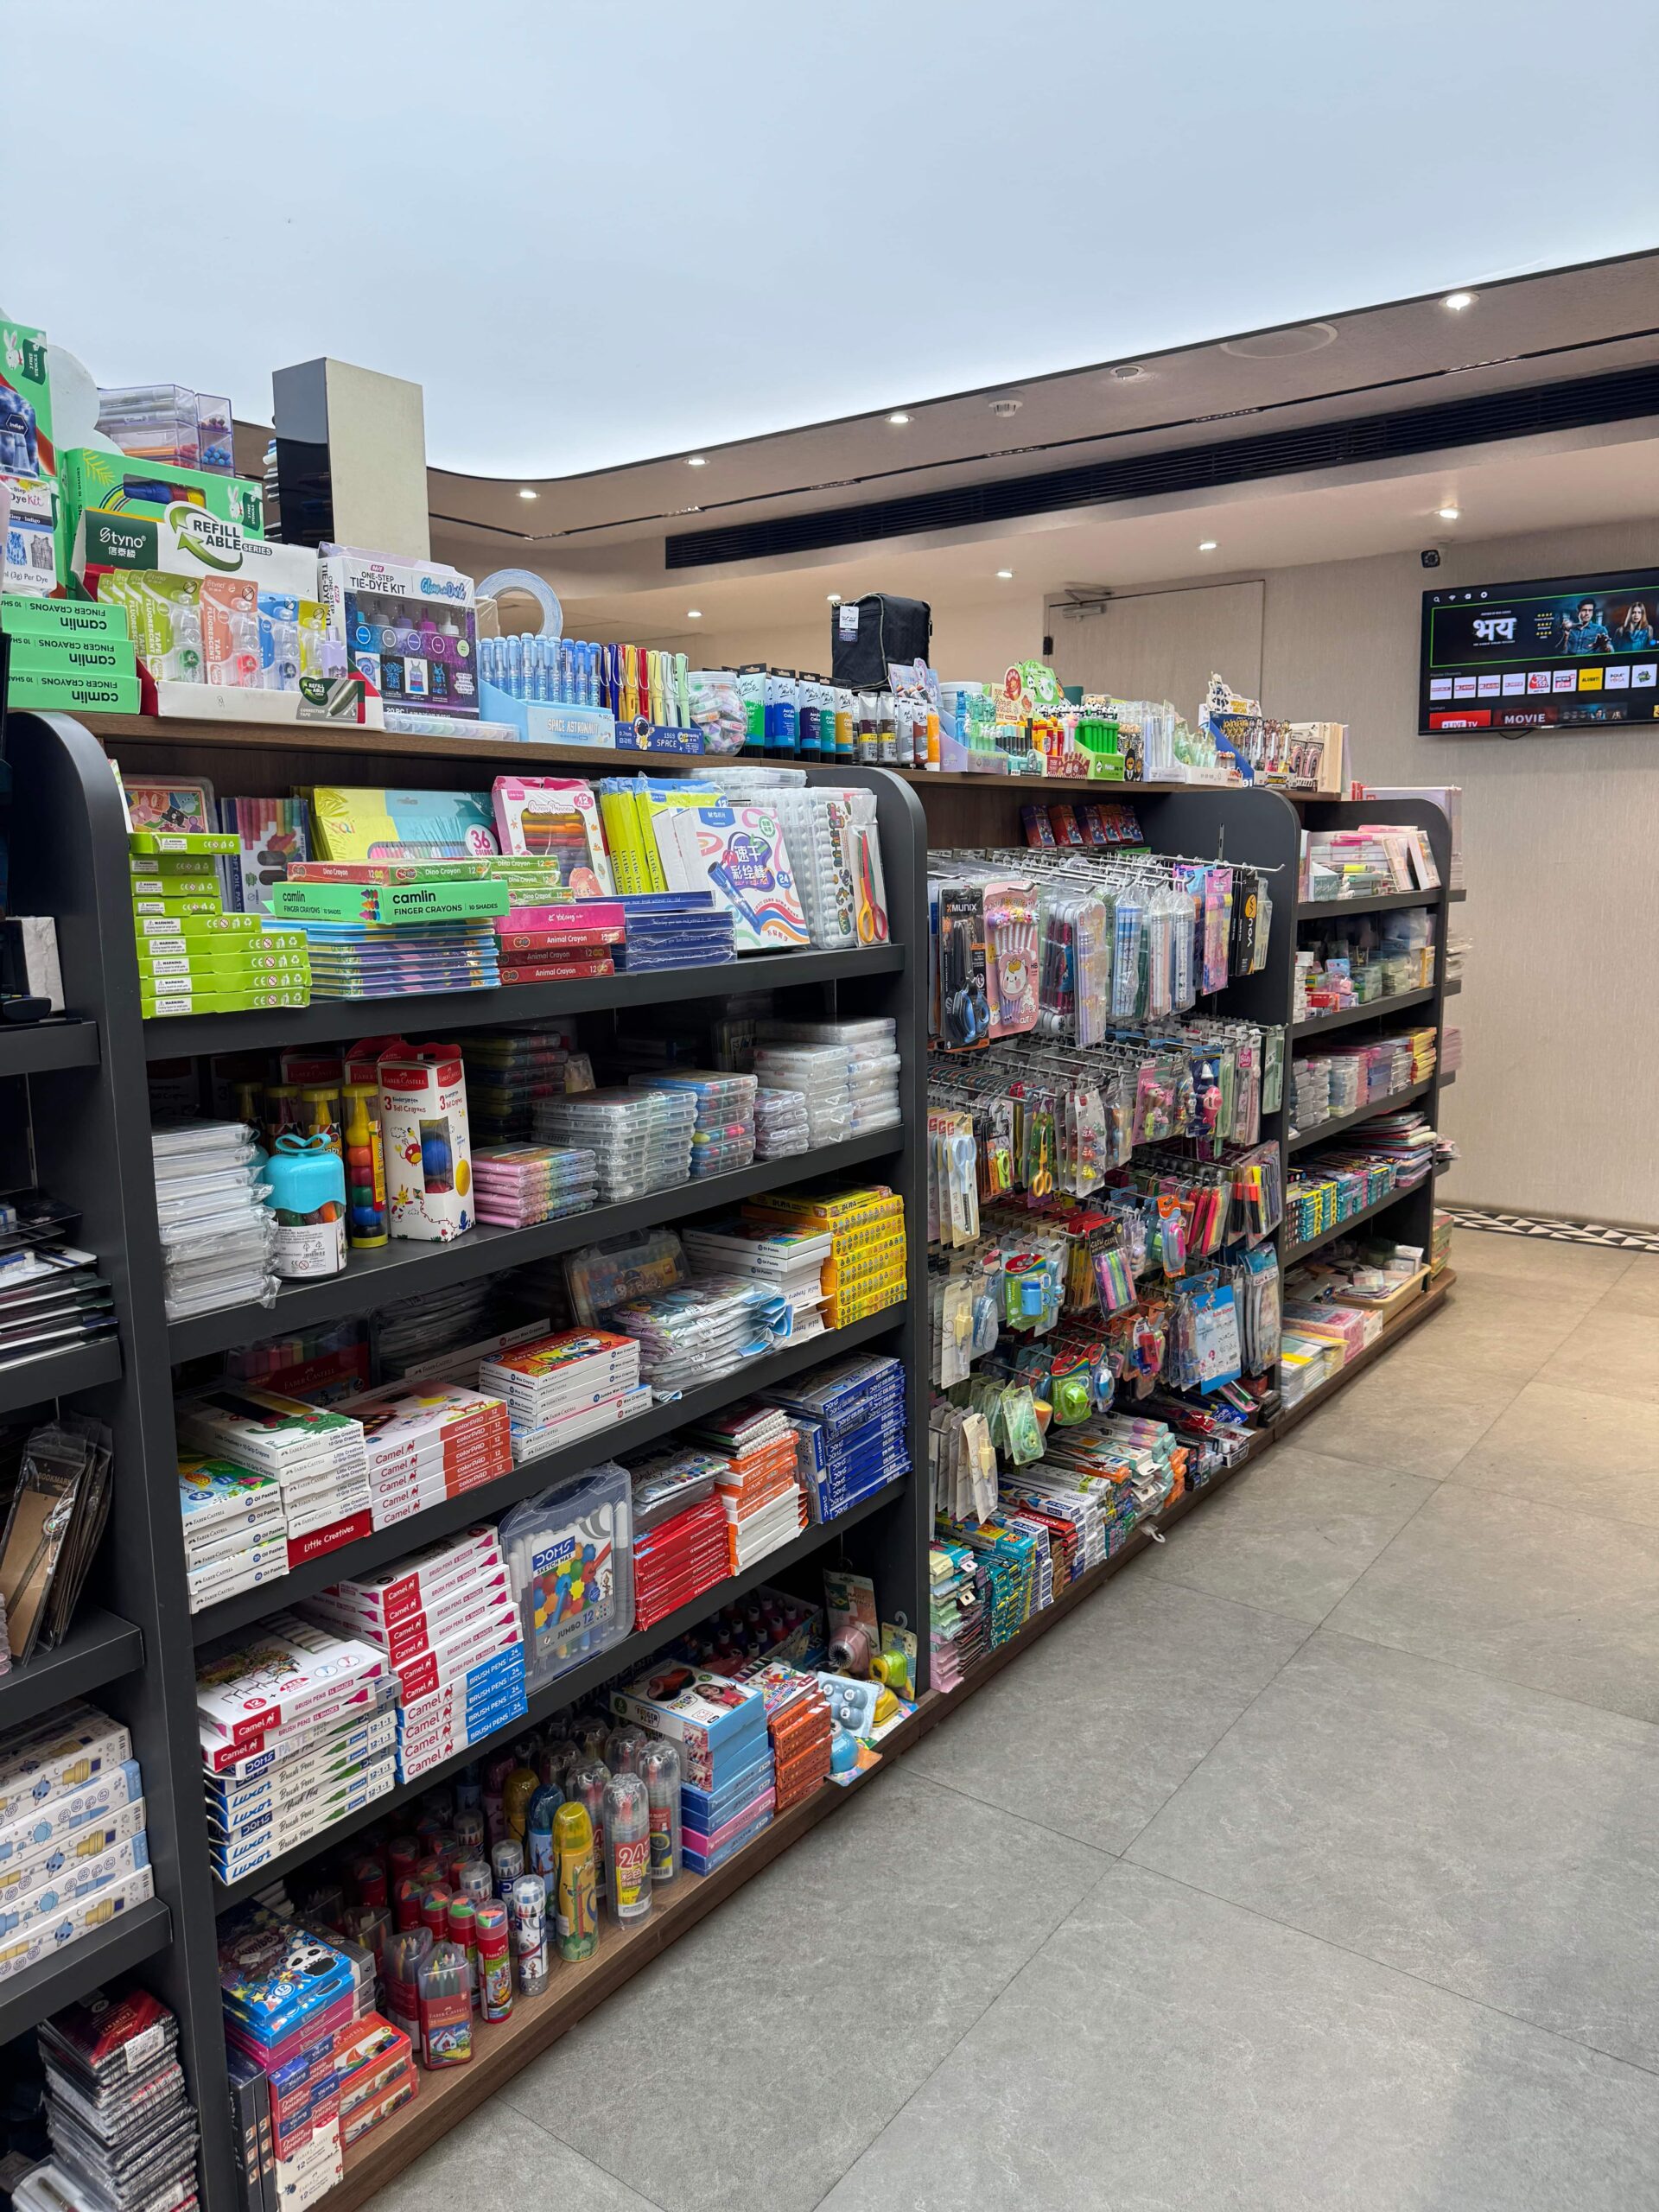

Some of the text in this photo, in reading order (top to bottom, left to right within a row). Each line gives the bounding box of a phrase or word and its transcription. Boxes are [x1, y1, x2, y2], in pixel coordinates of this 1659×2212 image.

[10, 422, 24, 430] Indigo
[27, 494, 44, 506] Kit
[194, 519, 240, 538] REFILL
[99, 527, 143, 549] Styno
[206, 535, 271, 555] ABLE SERIES
[24, 572, 35, 581] Per
[35, 574, 48, 583] Dye
[361, 571, 394, 582] ONE-STEP
[350, 577, 405, 594] TIE-DYE KIT
[29, 603, 105, 616] FINGER CRAYONS
[60, 617, 107, 631] camlin
[145, 598, 156, 654] FLUORESCENT
[1473, 617, 1517, 641] भय
[39, 639, 114, 652] FINGER CRAYONS
[69, 653, 116, 666] camlin
[548, 718, 599, 734] SPACE ASTRONAUT
[1504, 714, 1546, 724] MOVIE
[657, 739, 677, 747] SPACE
[470, 830, 491, 849] 36
[735, 845, 761, 862] 速干
[334, 868, 348, 876] Crayon
[442, 867, 461, 876] Crayon
[731, 865, 767, 880] 彩绘棒
[779, 874, 789, 884] 24
[283, 892, 306, 903] camlin
[392, 890, 435, 904] camlin
[394, 905, 424, 916] FINGER
[425, 904, 462, 913] CRAYONS
[546, 935, 566, 944] Animal
[567, 935, 587, 944] Crayon
[535, 968, 556, 976] Animal
[556, 967, 575, 976] Crayon
[385, 1096, 391, 1110] 3
[440, 1096, 445, 1110] 3
[550, 1406, 577, 1420] FABER-CASTELL
[341, 1428, 361, 1437] Creatives
[344, 1433, 361, 1442] Crayons
[289, 1440, 321, 1454] FABER-CASTELL
[375, 1450, 404, 1464] Camel
[454, 1416, 484, 1432] colorPAD
[384, 1507, 410, 1523] Camel
[459, 1471, 487, 1488] colorPAD
[193, 1510, 225, 1525] FABER-CASTELL
[262, 1489, 278, 1499] Pastels
[1018, 1510, 1058, 1526] NATARAJ
[304, 1524, 354, 1553] Little Creatives
[536, 1539, 574, 1566] DOMS
[202, 1567, 233, 1583] FABER-CASTELL
[269, 1545, 285, 1555] Pastels
[537, 1554, 573, 1575] SKETCH MAX
[432, 1567, 476, 1597] BRUSH PENS SHADES
[389, 1585, 408, 1599] Camel
[556, 1610, 594, 1639] JUMBO 12
[404, 1665, 424, 1680] Camel
[408, 1647, 518, 1719] Camel BRUSH PENS 24
[238, 1680, 353, 1737] Camel BRUSH PENS SHADES
[248, 1700, 260, 1708] 12
[220, 1717, 311, 1762] Camel BRUSH PENS
[407, 1702, 521, 1776] Camel BRUSH PENS 24
[246, 1751, 275, 1771] DOMS
[279, 1769, 297, 1783] Brush
[619, 1844, 645, 1868] 24
[620, 1868, 642, 1882] 彩色
[297, 2160, 306, 2171] 12
